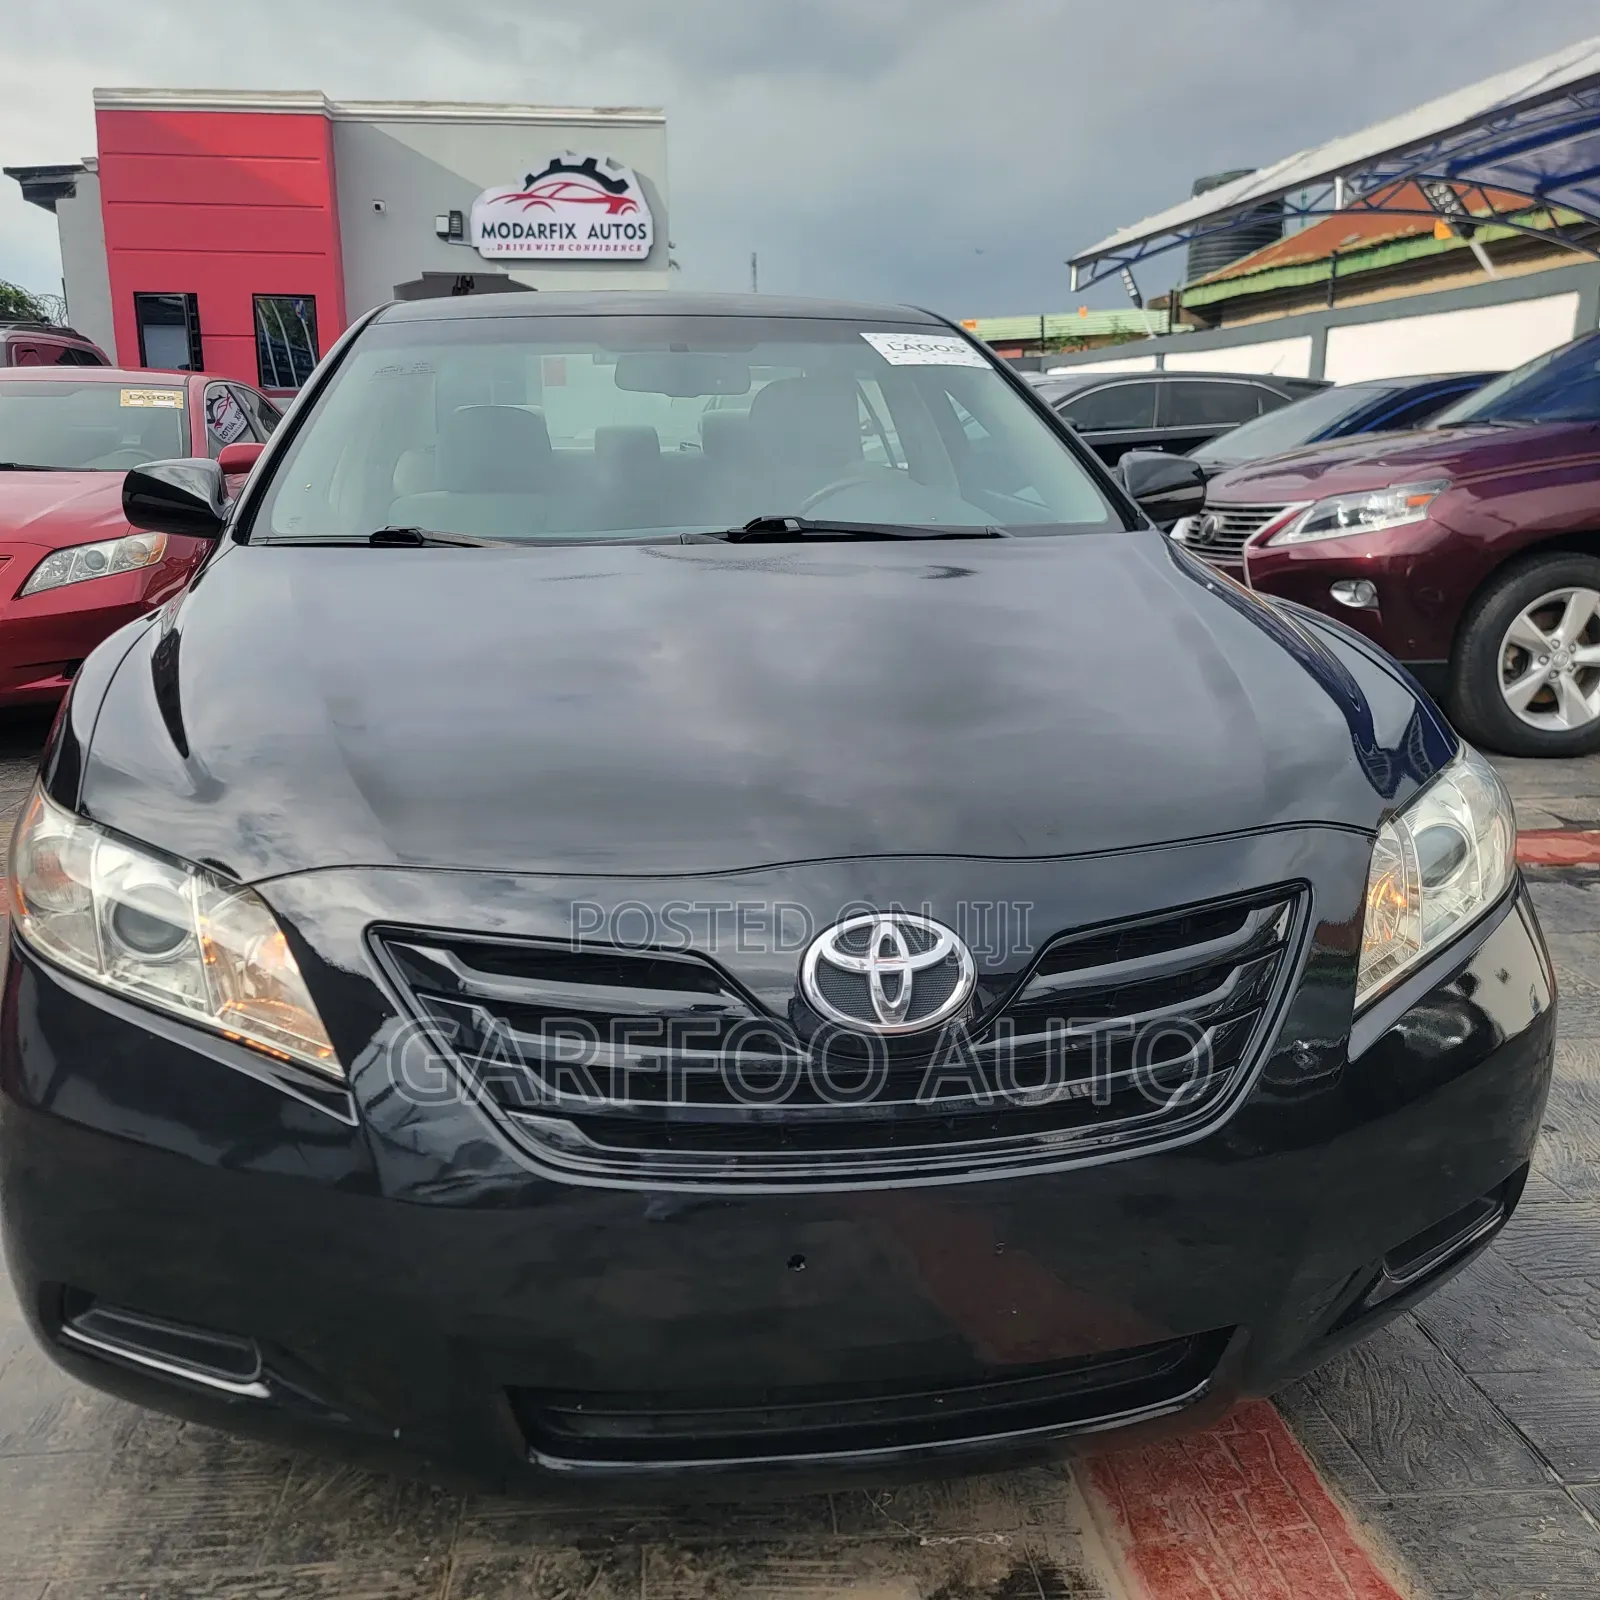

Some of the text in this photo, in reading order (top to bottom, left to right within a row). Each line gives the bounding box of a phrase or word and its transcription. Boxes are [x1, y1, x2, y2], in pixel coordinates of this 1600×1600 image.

[481, 222, 647, 240] MODARFIX AUTOS
[536, 244, 565, 252] WITH
[568, 244, 642, 252] CONFIDENCE
[886, 342, 966, 353] LAGOS
